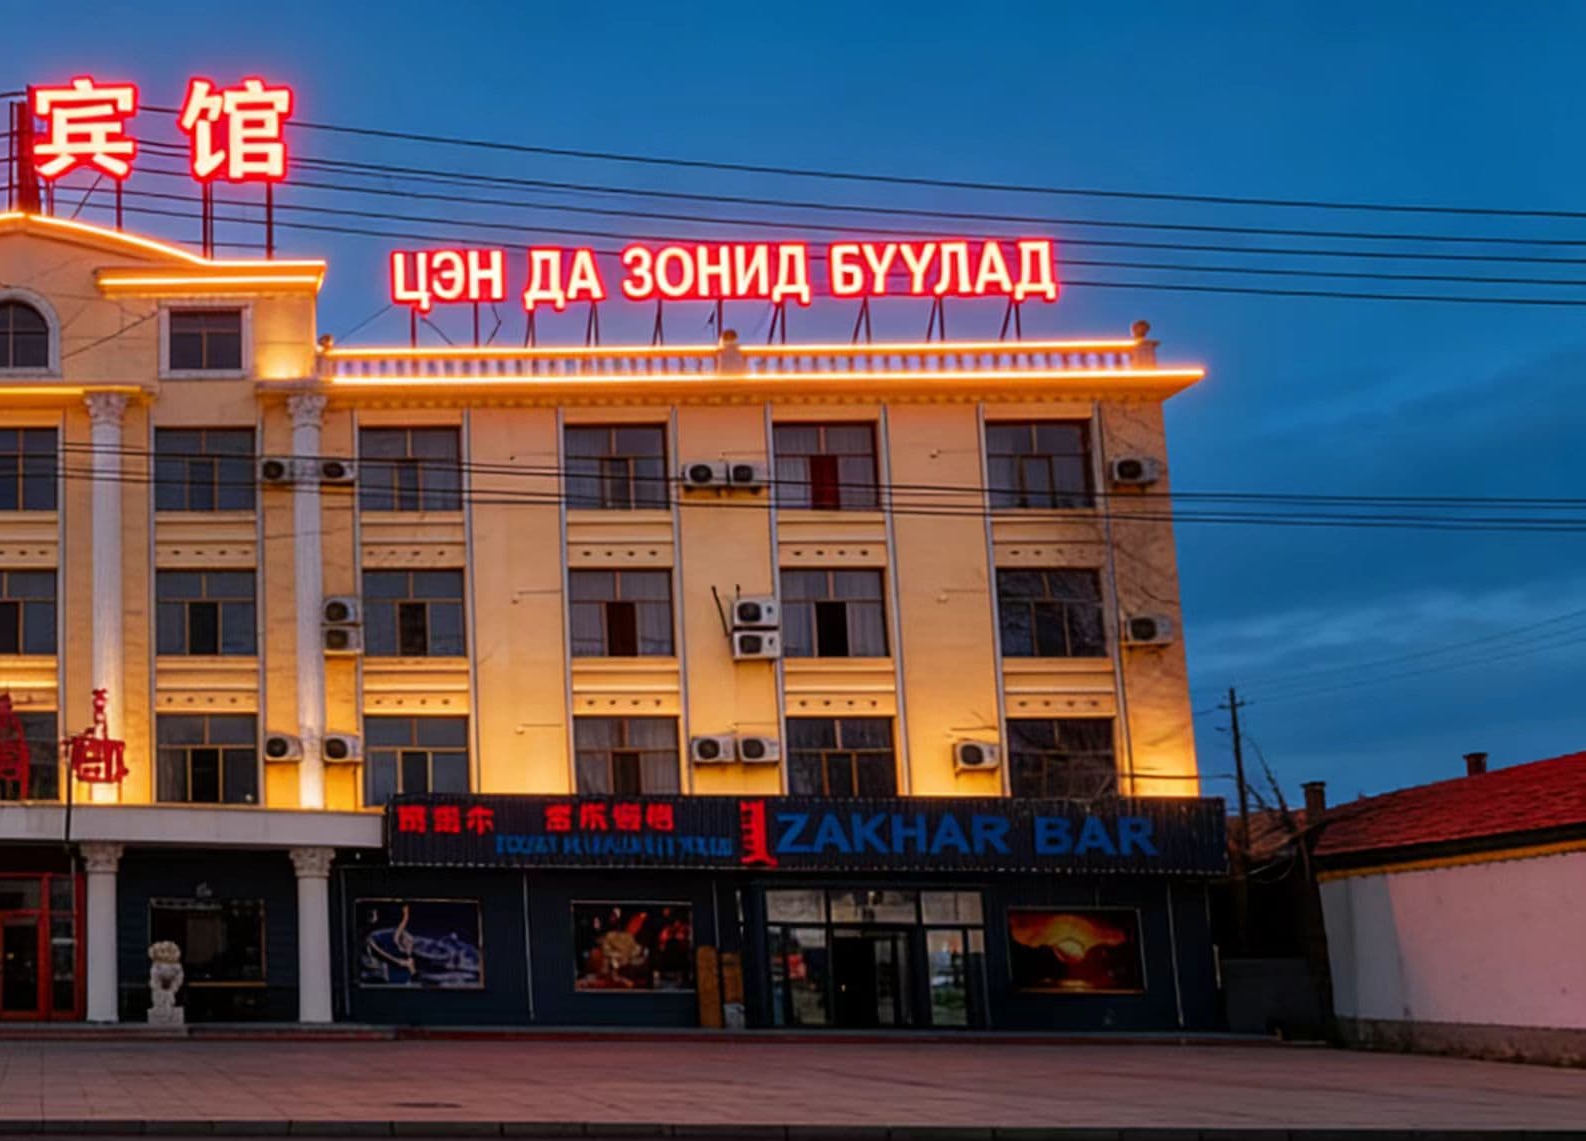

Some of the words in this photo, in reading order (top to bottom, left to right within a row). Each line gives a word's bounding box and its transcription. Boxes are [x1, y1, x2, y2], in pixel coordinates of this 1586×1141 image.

[392, 250, 505, 312] ЦЭН
[524, 247, 605, 311] ДА
[622, 243, 811, 303] ЗОНИД
[775, 812, 1012, 855] ZAKHAR
[1034, 815, 1159, 857] BAR
